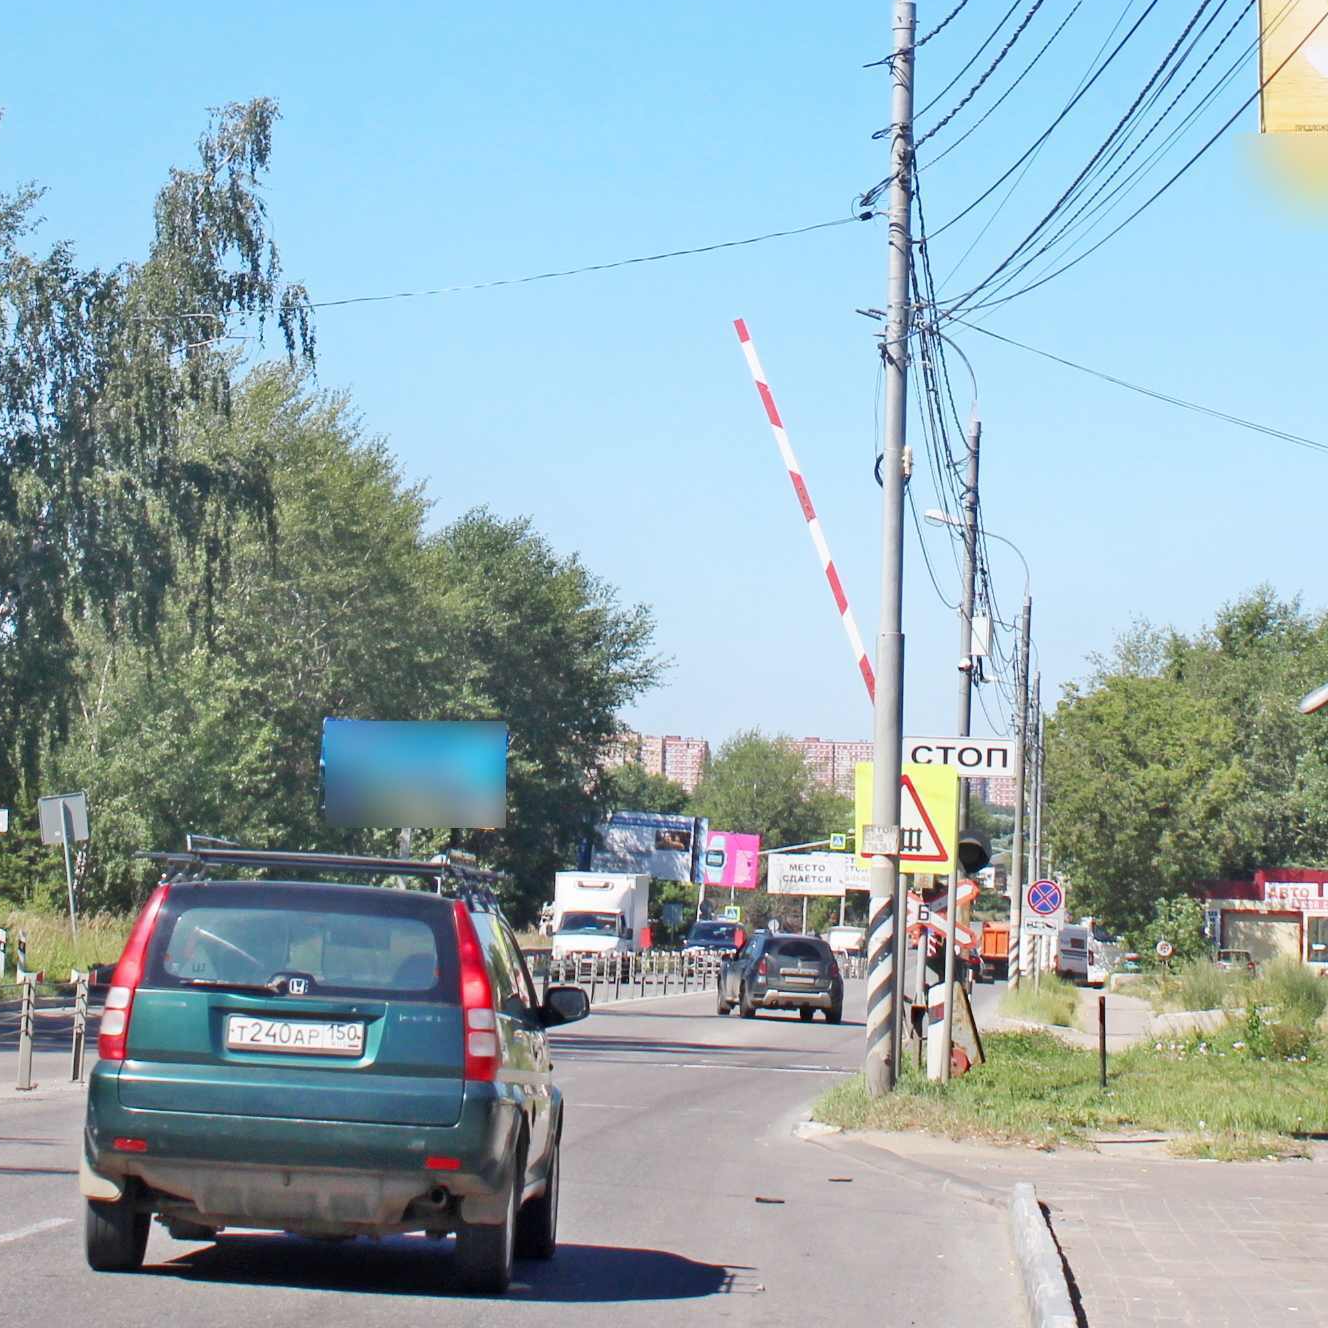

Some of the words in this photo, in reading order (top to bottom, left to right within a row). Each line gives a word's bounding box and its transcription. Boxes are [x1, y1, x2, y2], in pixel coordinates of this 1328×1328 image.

[911, 745, 1008, 768] СТОП
[789, 863, 826, 872] МЕСТО
[782, 873, 832, 883] СДАЁТСЯ
[1269, 886, 1310, 899] АВТО
